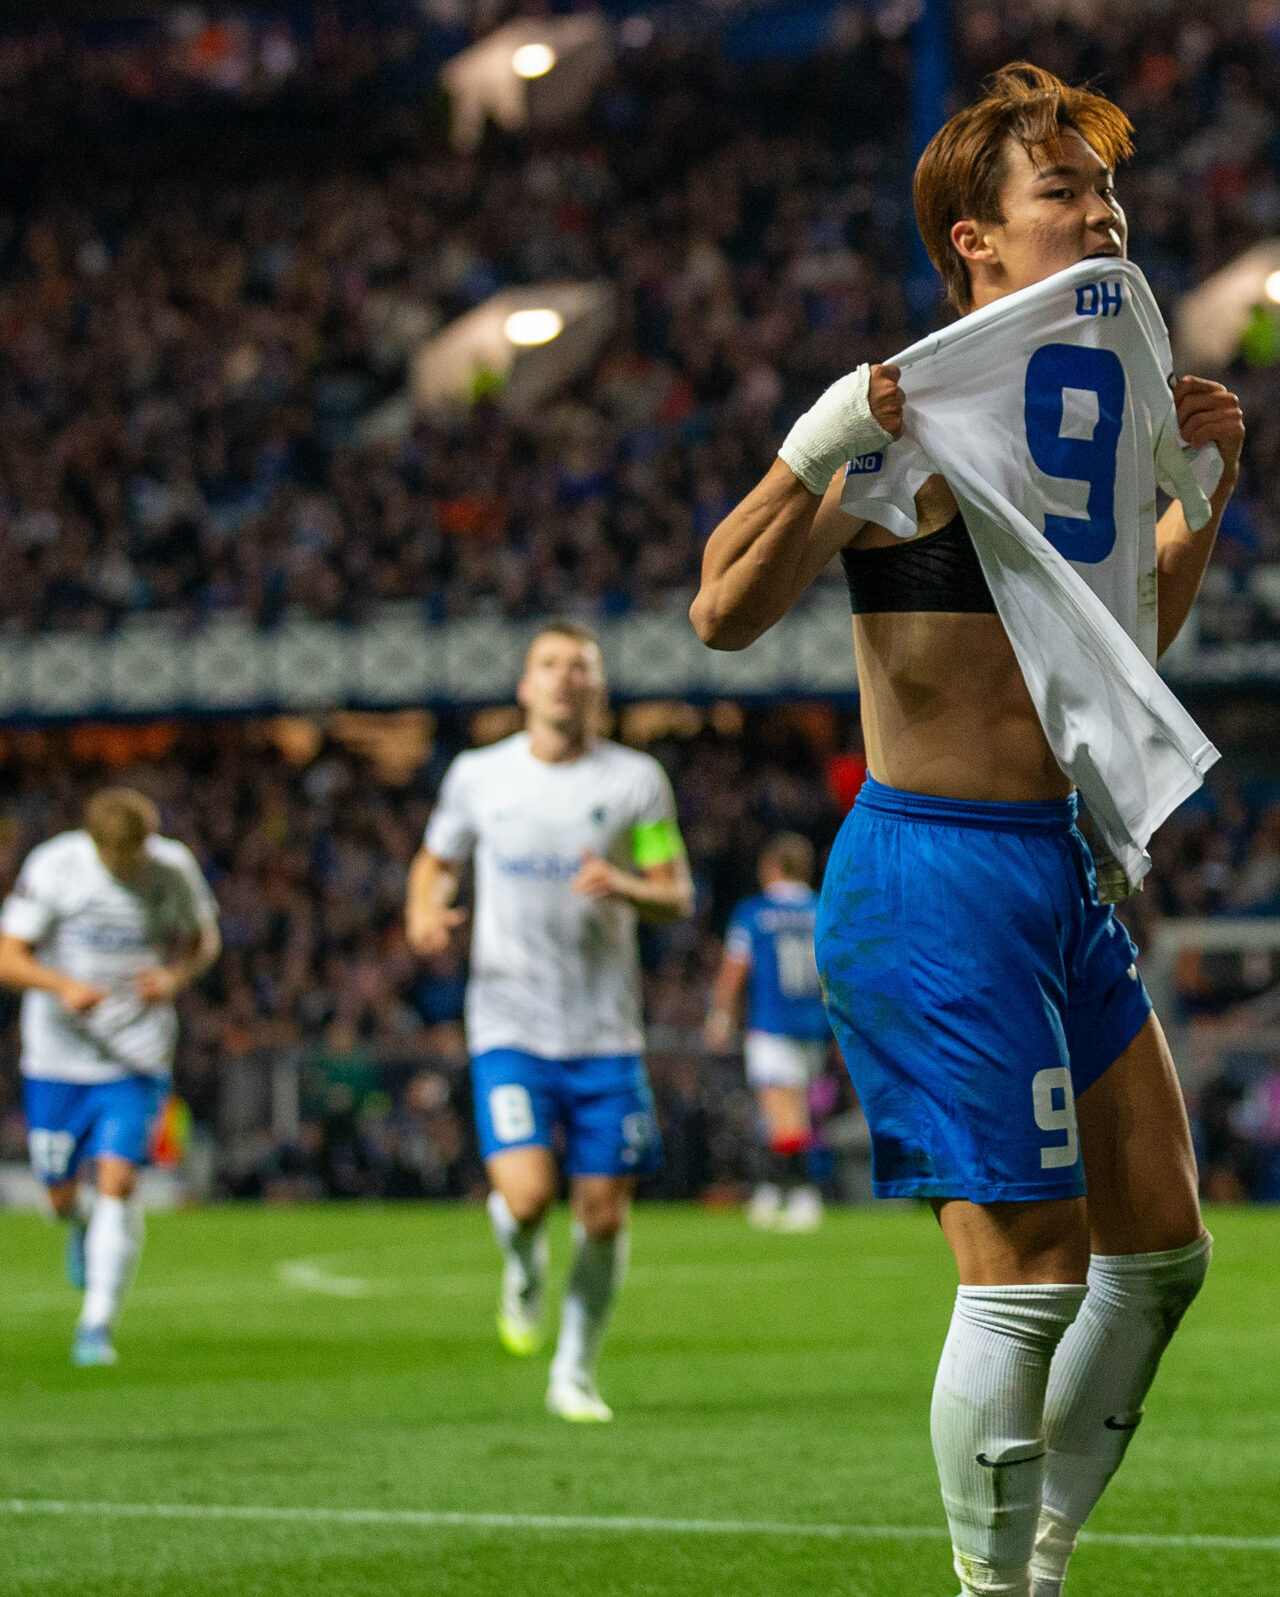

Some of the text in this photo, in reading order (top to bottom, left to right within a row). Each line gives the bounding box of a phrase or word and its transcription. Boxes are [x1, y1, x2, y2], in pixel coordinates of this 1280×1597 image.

[1075, 281, 1122, 317] OH
[1024, 342, 1125, 564] 9
[1031, 1066, 1079, 1169] 9
